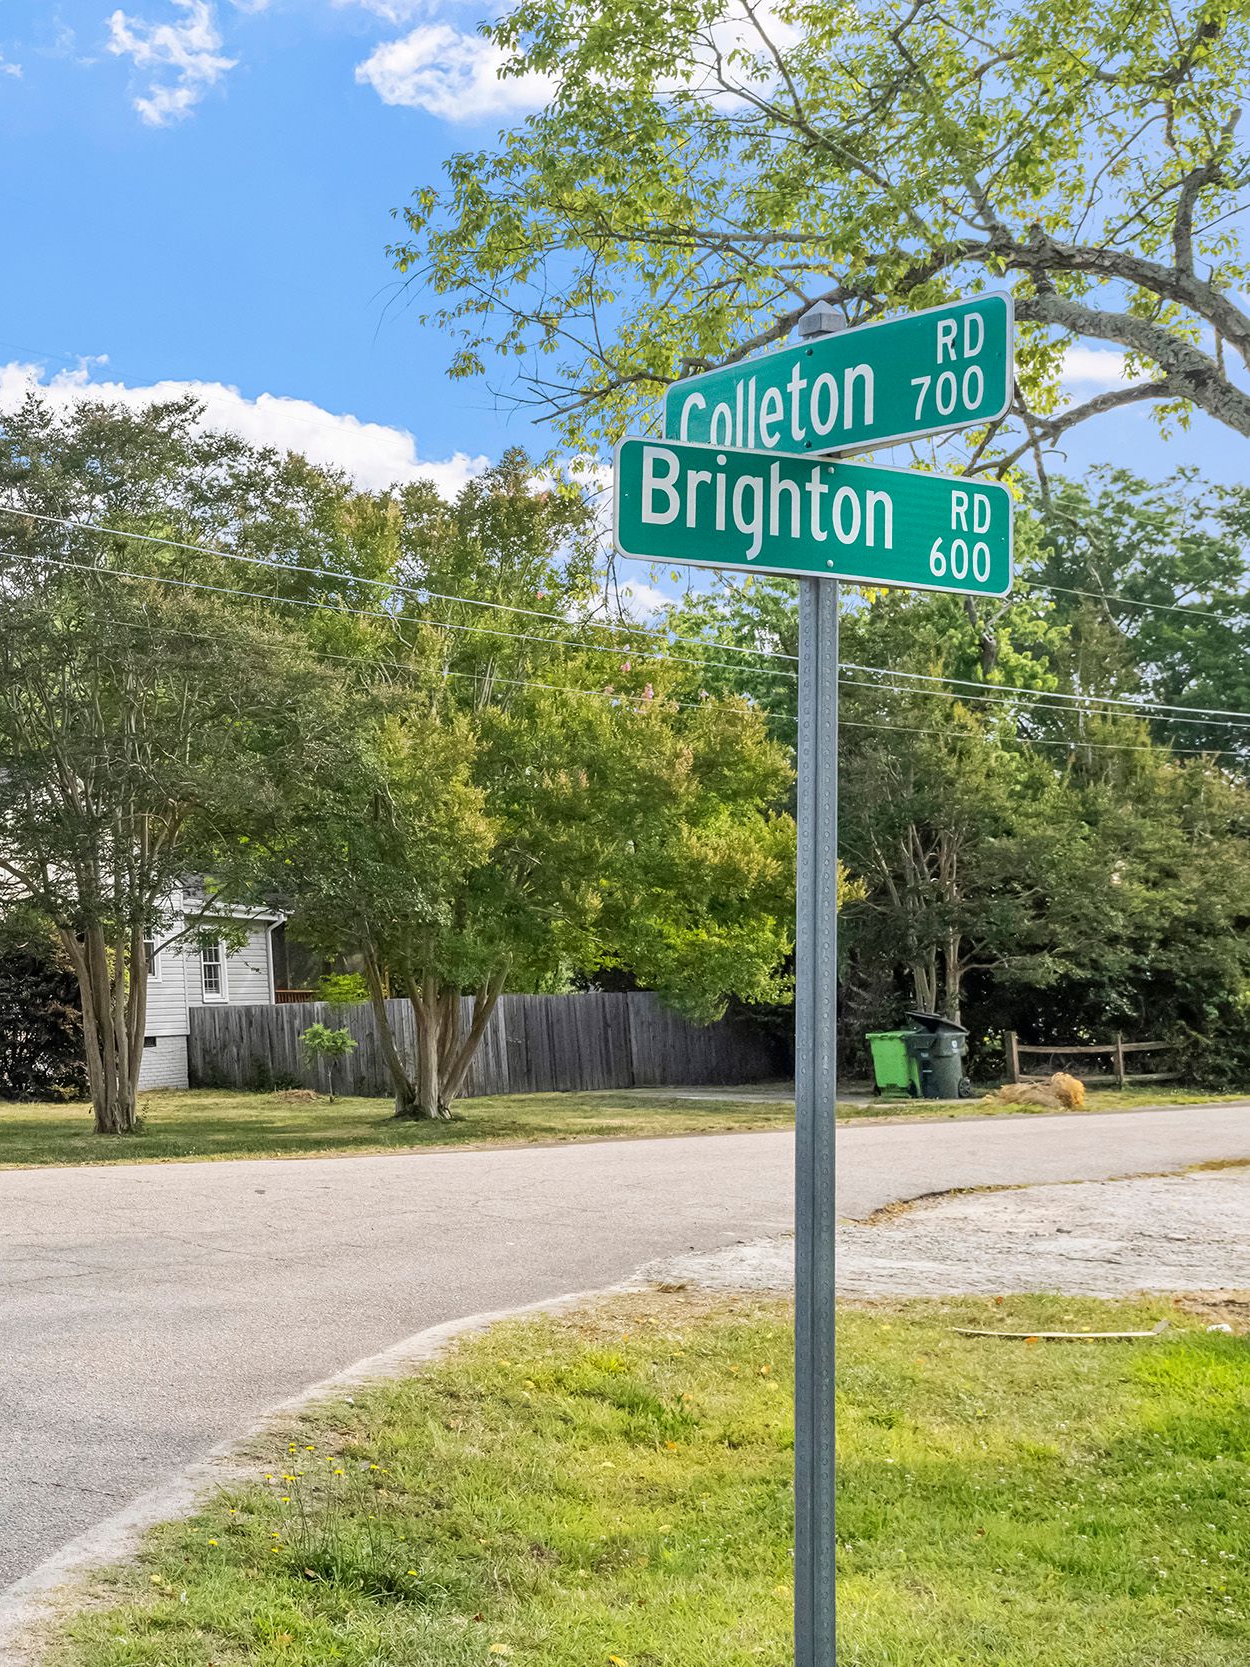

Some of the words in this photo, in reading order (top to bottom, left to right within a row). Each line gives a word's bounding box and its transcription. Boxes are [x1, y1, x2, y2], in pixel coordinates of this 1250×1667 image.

[937, 313, 984, 364] RD
[680, 362, 874, 449] Colleton
[911, 365, 983, 420] 700
[642, 447, 893, 560] Brighton
[951, 490, 991, 533] RD
[929, 537, 990, 582] 600
